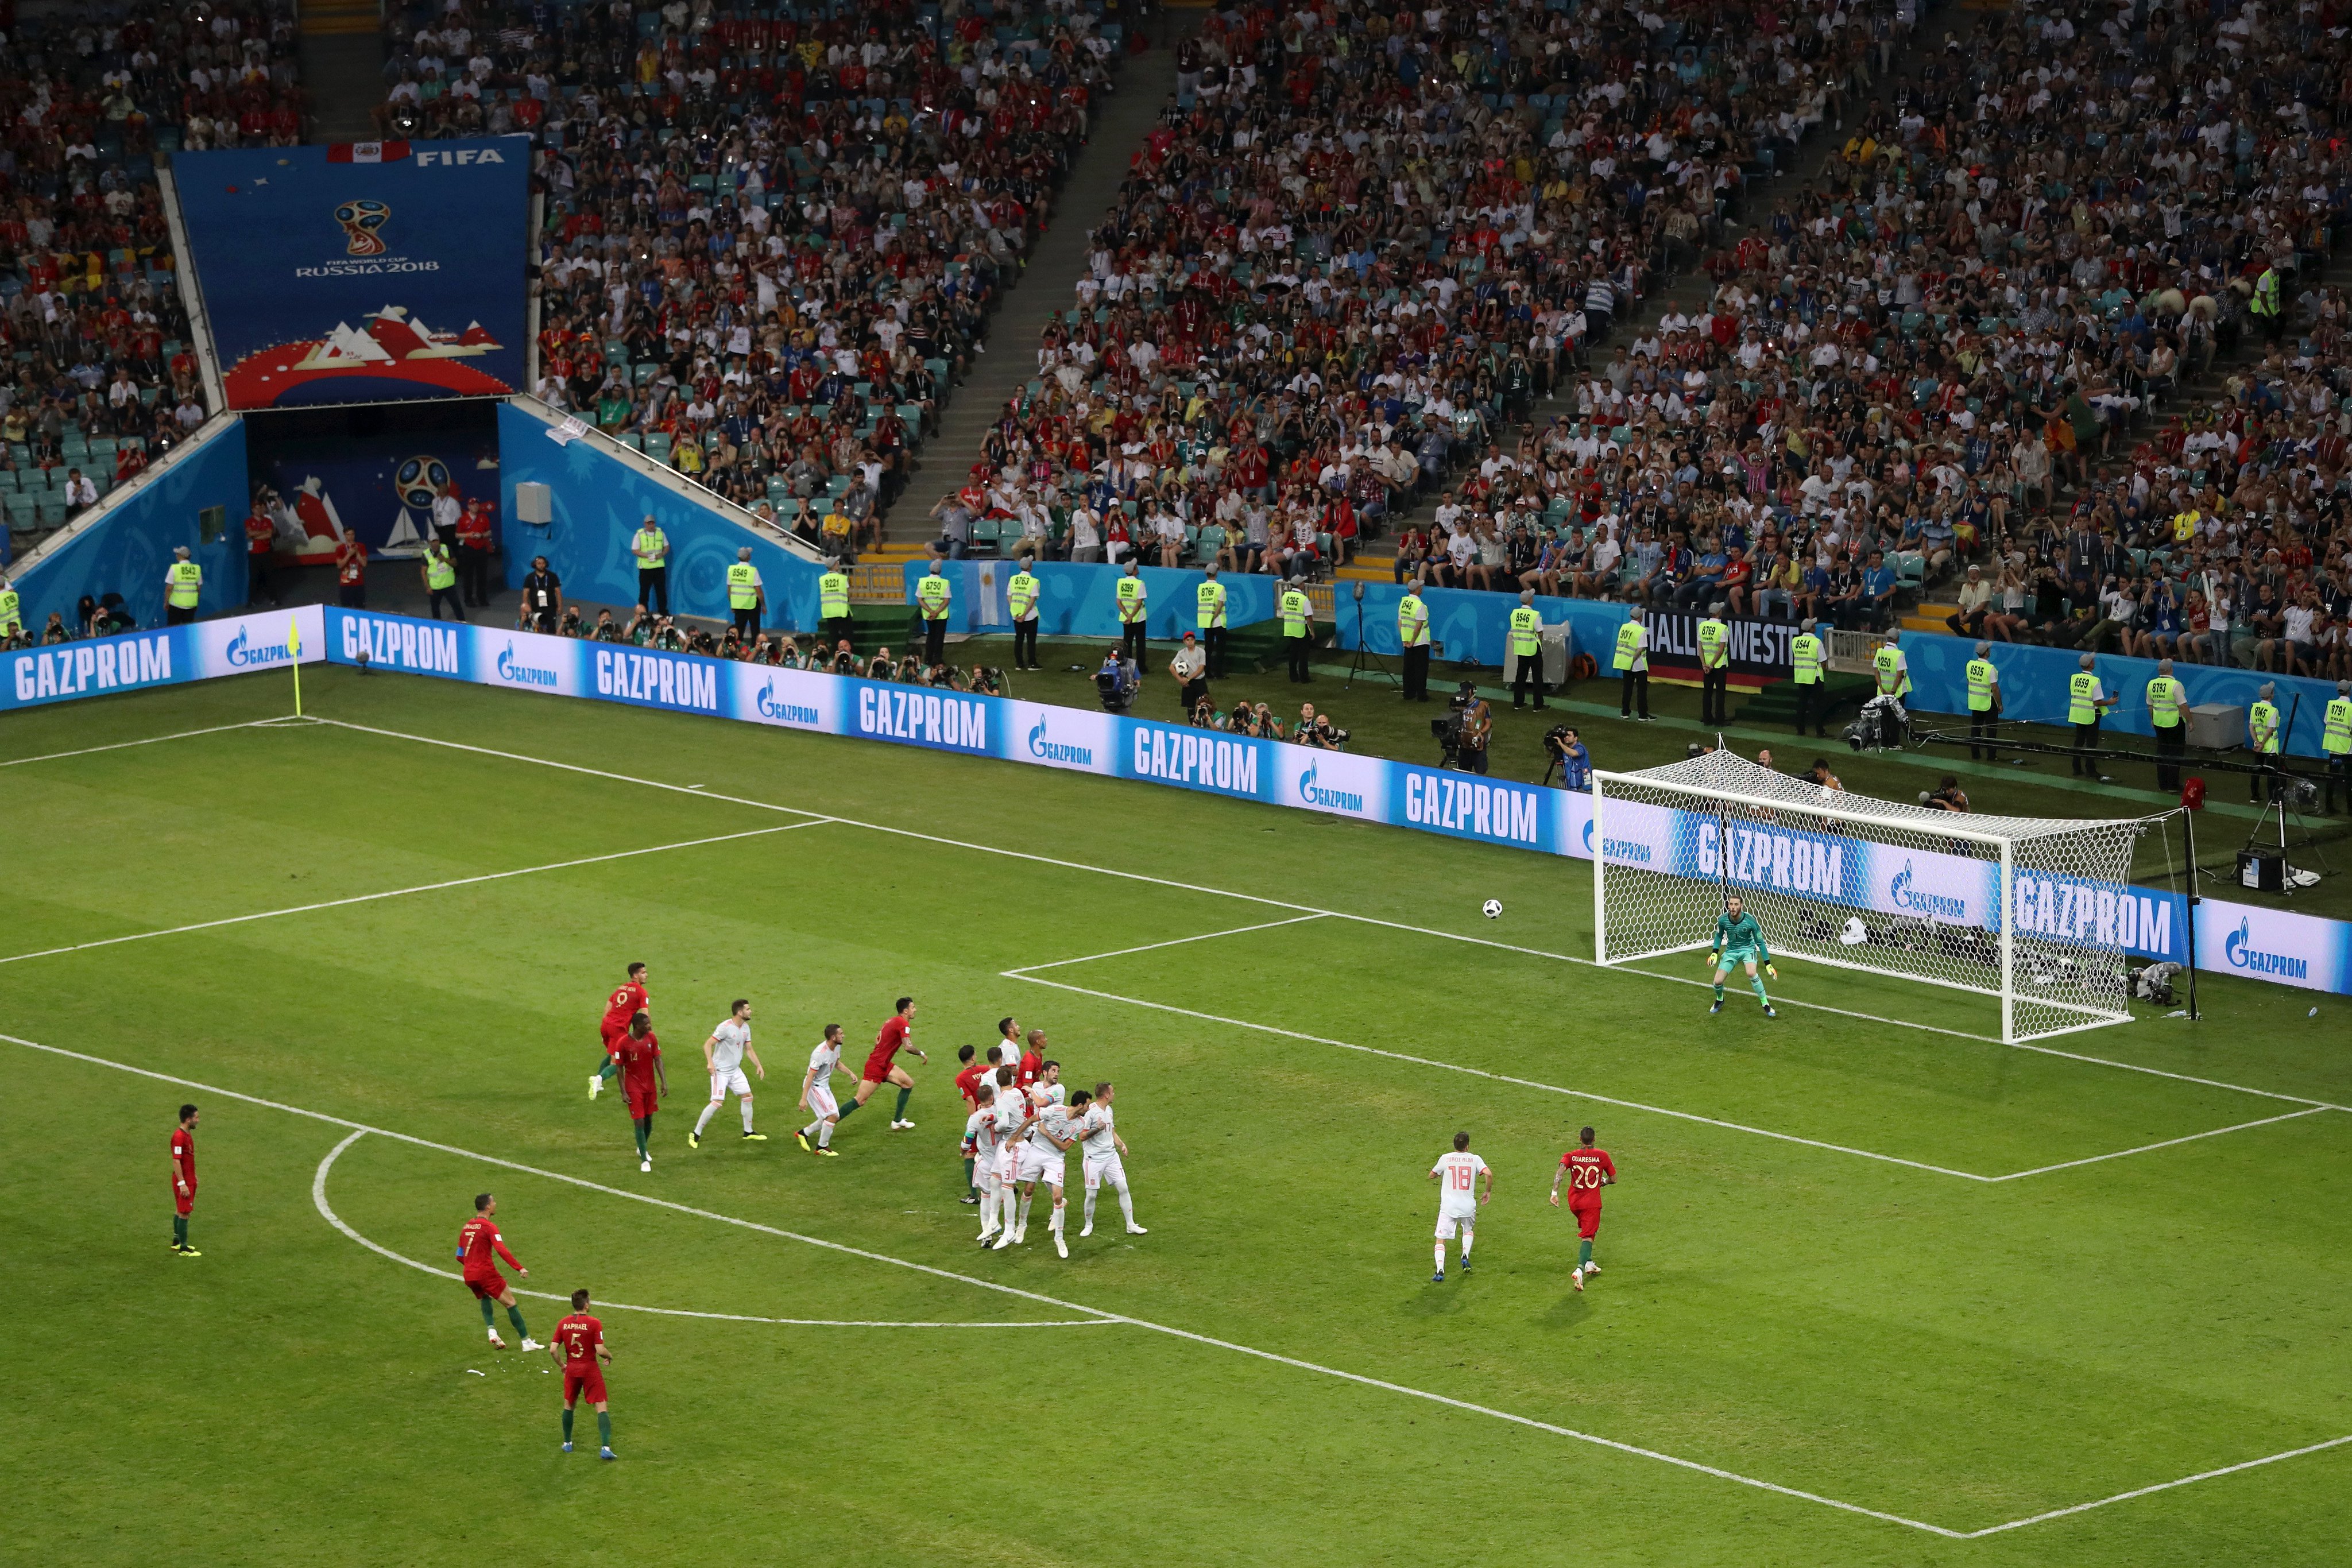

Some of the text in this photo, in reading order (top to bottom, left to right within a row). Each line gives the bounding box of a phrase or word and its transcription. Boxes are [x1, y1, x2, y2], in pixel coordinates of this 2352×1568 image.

[417, 149, 504, 167] FIFA
[296, 261, 440, 277] RUSSIA 2018
[825, 579, 839, 589] 9221
[926, 582, 941, 591] 8750
[1516, 613, 1530, 623] 8546
[1702, 626, 1716, 636] 8769
[343, 615, 458, 673] GAZPROM
[1795, 640, 1811, 649] 8544
[15, 636, 171, 701] GAZPROM
[516, 667, 557, 687] GAZPROM
[1970, 665, 1984, 676] 8535
[597, 649, 717, 710] GAZPROM
[2075, 677, 2090, 689] 8559
[2152, 683, 2167, 693] 8793
[776, 703, 818, 725] GAZPROM
[860, 687, 985, 749] GAZPROM
[2331, 704, 2347, 717] 8791
[1047, 746, 1092, 765] GAZPROM
[1134, 727, 1256, 793] GAZPROM
[1318, 788, 1363, 812] GAZPROM
[1406, 773, 1537, 843] GAZPROM
[1699, 823, 1842, 897] GAZPROM
[1913, 893, 1965, 918] GAZPROM
[2016, 877, 2171, 955] GAZPROM
[2249, 952, 2307, 979] GAZPROM
[1057, 1129, 1064, 1139] 5
[1004, 1170, 1010, 1180] 3
[1057, 1172, 1063, 1183] 5
[1448, 1166, 1472, 1190] 18
[1572, 1165, 1600, 1189] 20
[465, 1232, 476, 1257] 7
[571, 1333, 585, 1358] 5
